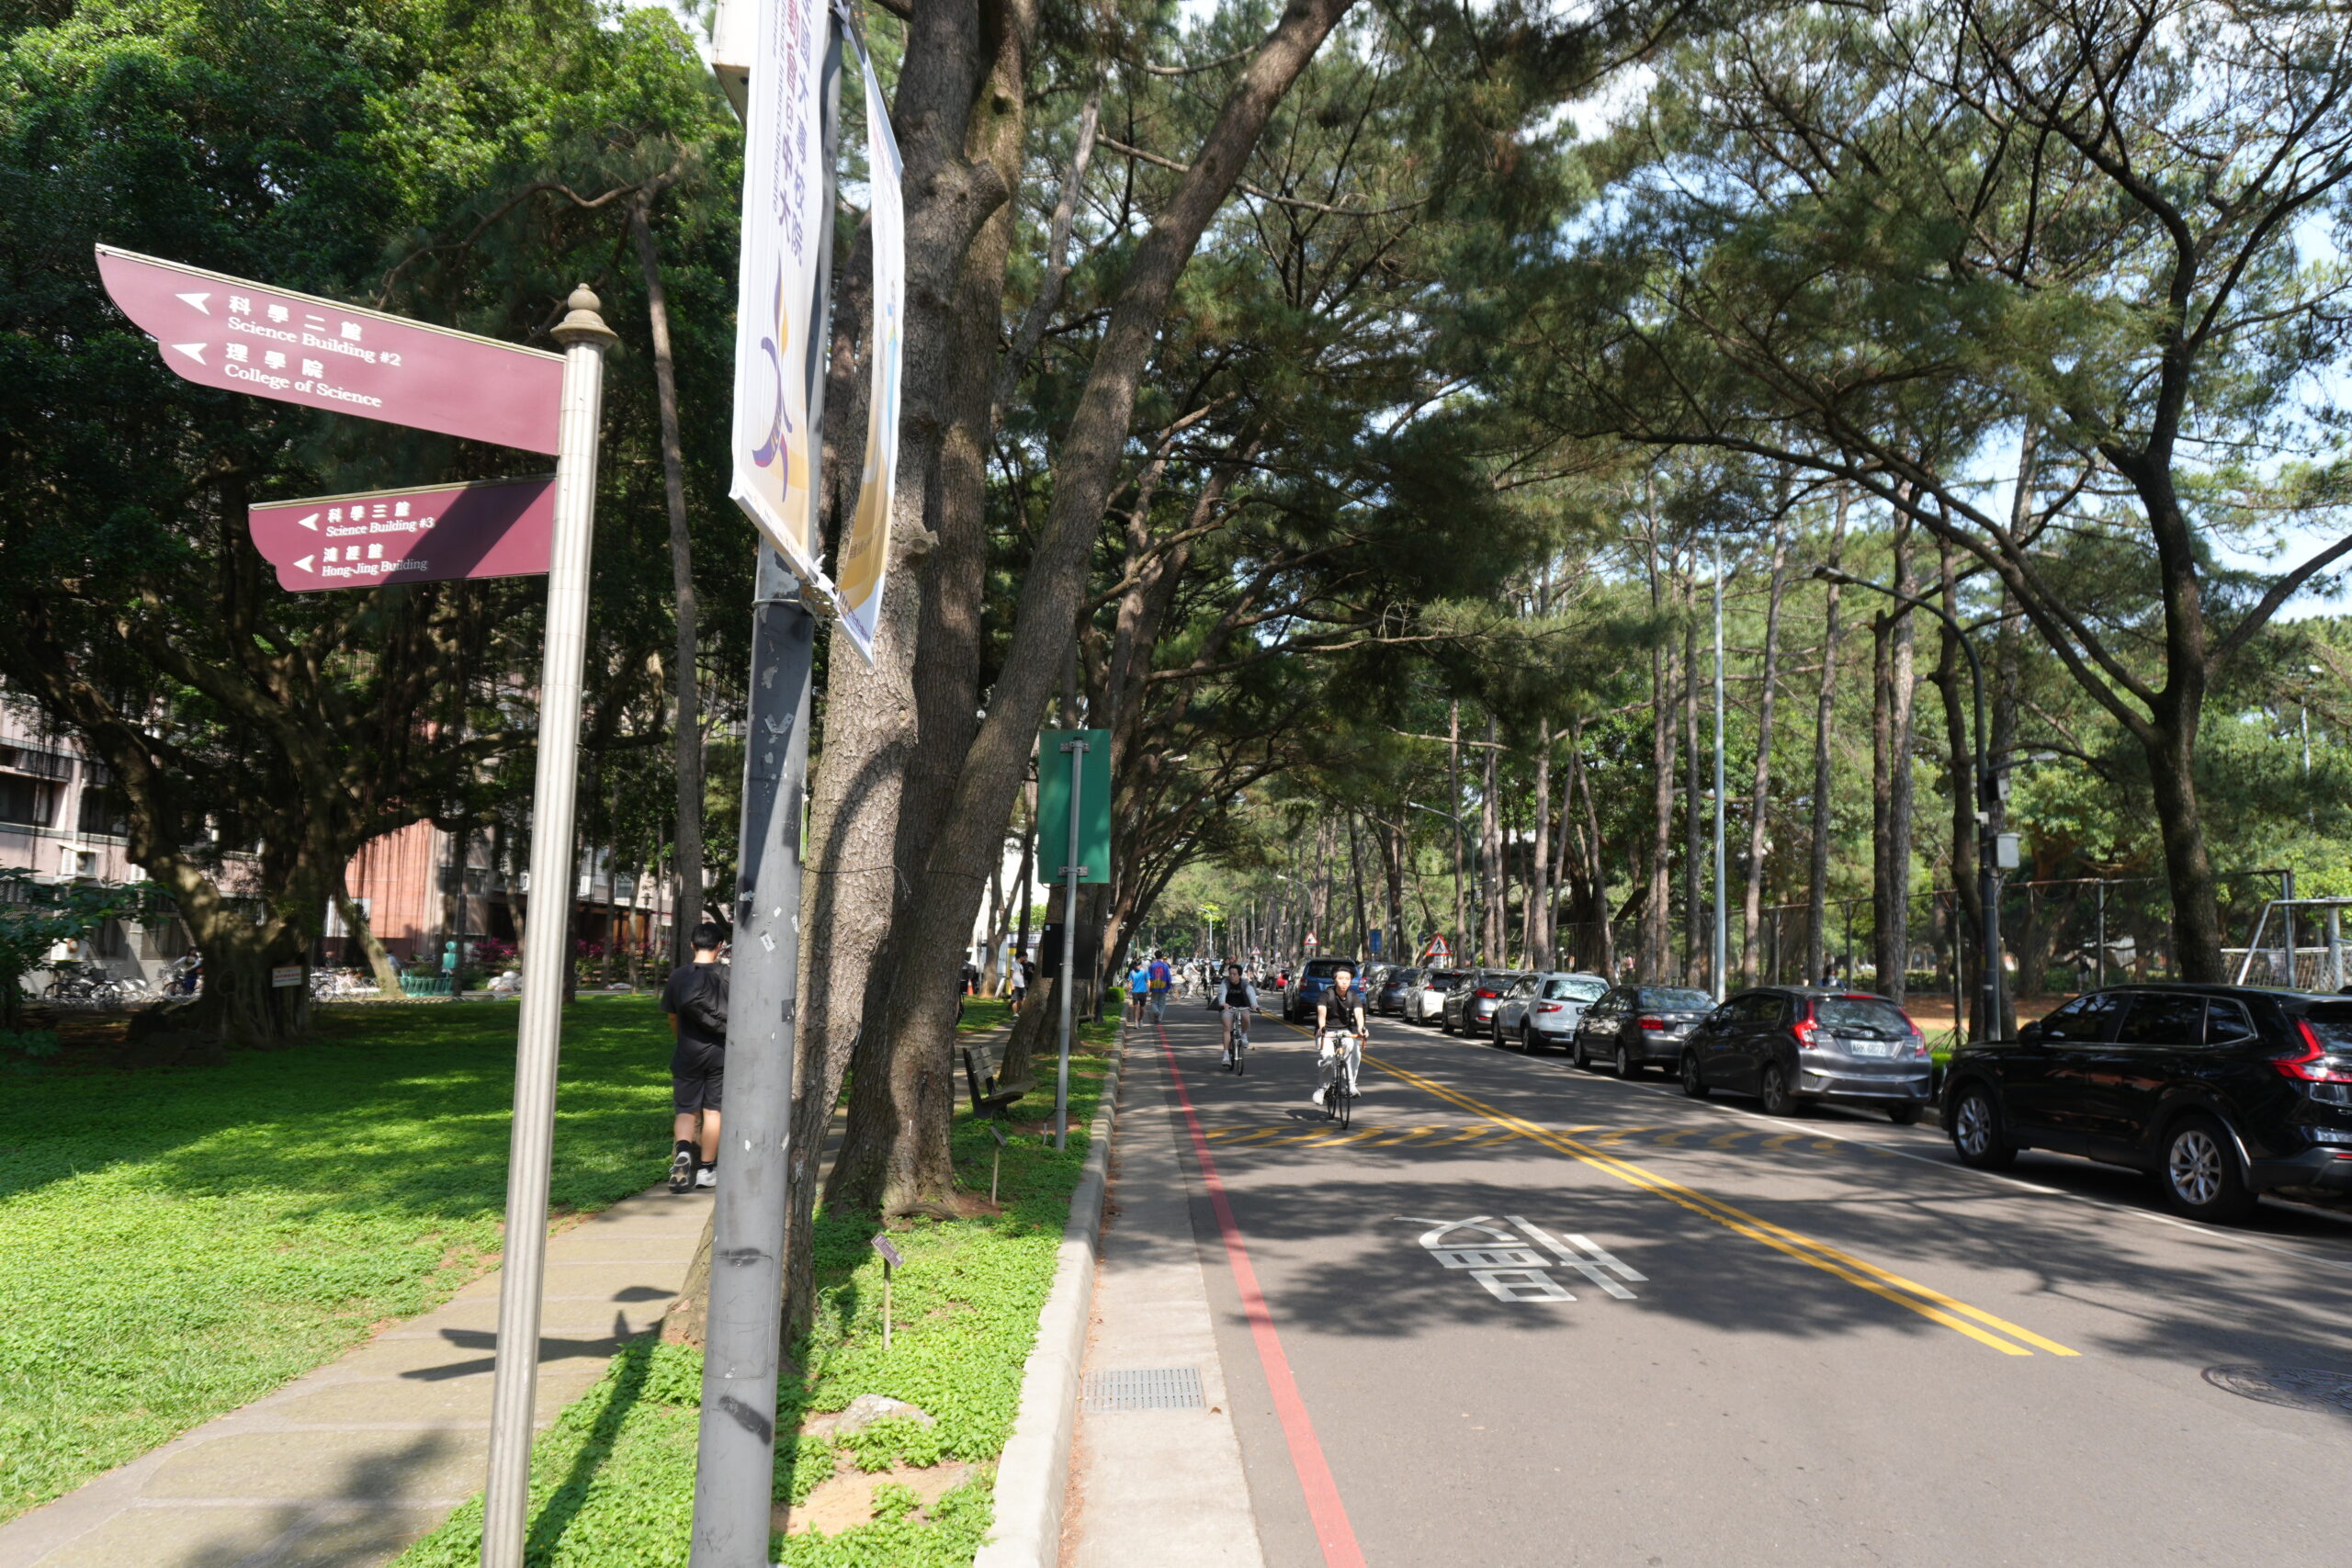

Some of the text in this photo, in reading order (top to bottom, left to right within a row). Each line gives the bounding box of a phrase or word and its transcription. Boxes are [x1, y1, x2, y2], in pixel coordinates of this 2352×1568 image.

[229, 295, 361, 341] 科學二館
[228, 316, 401, 367] Science Building #2
[225, 342, 324, 378] 理學院
[224, 363, 382, 407] College of Science
[326, 516, 435, 536] Science Building #3
[327, 501, 411, 523] 科學三館
[322, 559, 428, 578] Hong-Jing Building
